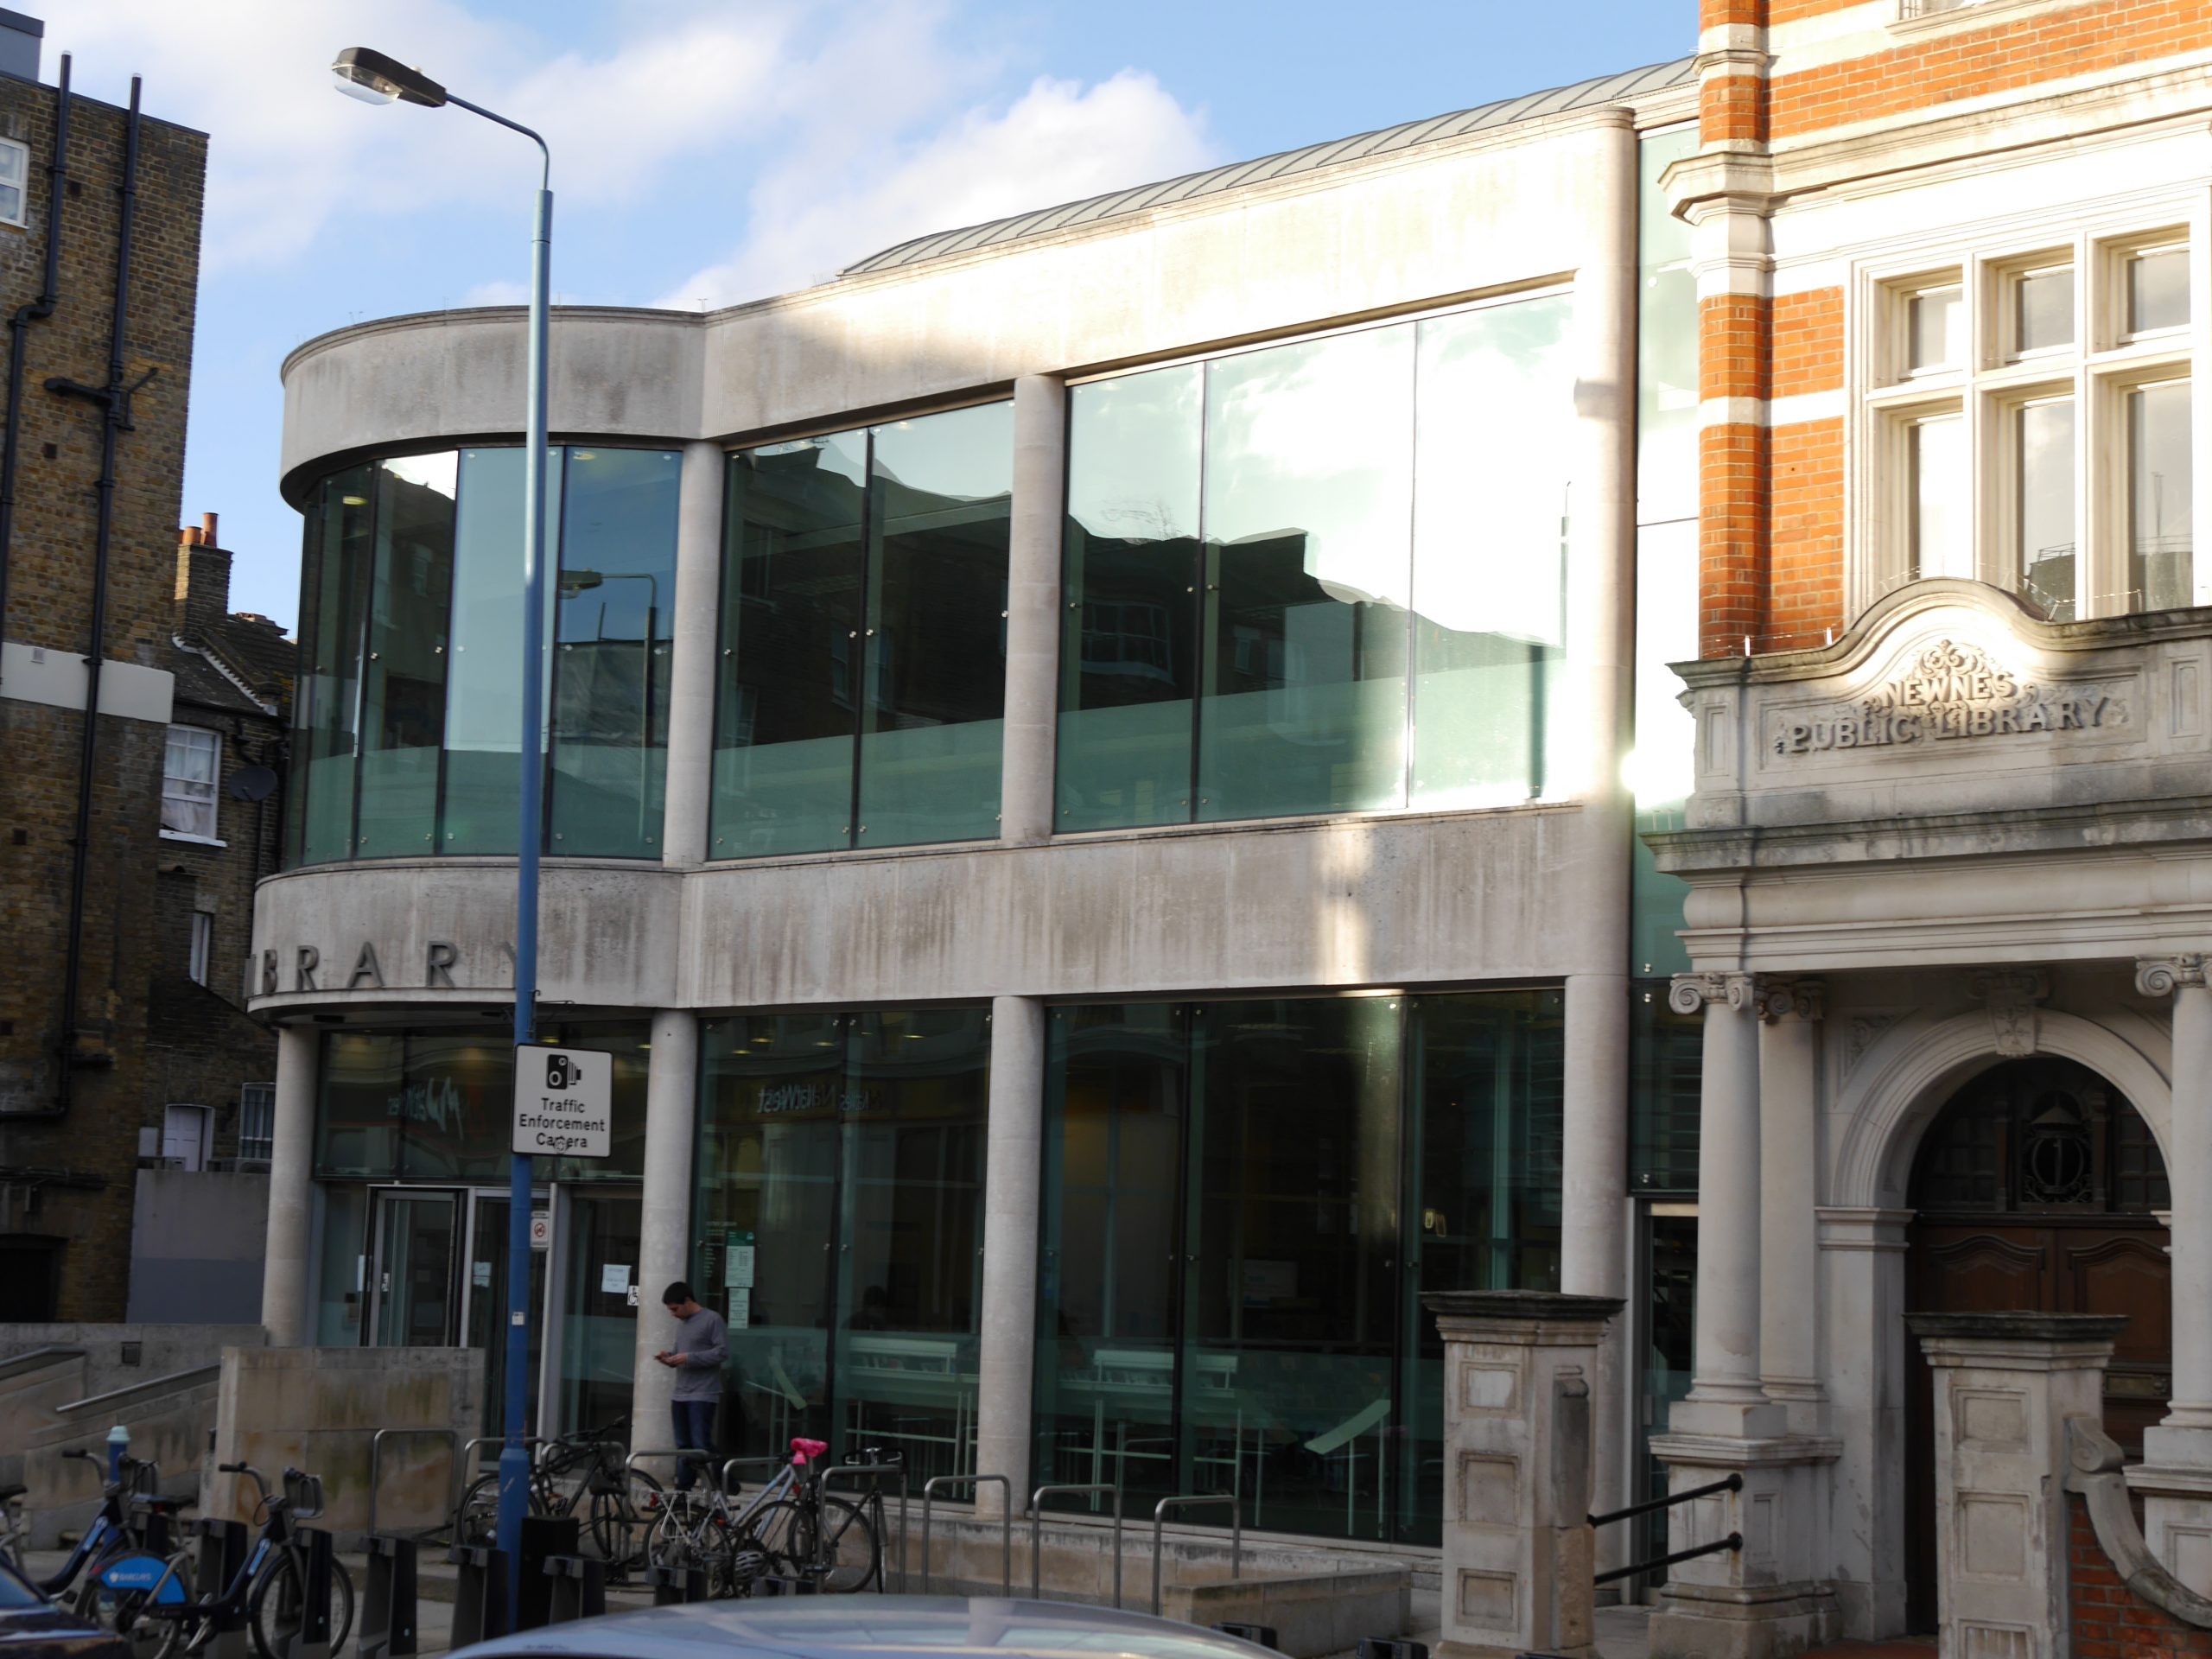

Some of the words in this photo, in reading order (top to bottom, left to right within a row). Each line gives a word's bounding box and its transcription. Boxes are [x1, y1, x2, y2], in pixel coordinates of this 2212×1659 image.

[1883, 671, 2015, 707] NEWNES
[1789, 715, 1920, 753] PUBLIC
[1935, 696, 2110, 741] LIBRARY
[541, 1097, 585, 1113] Traffic
[518, 1114, 605, 1132] Enforcement
